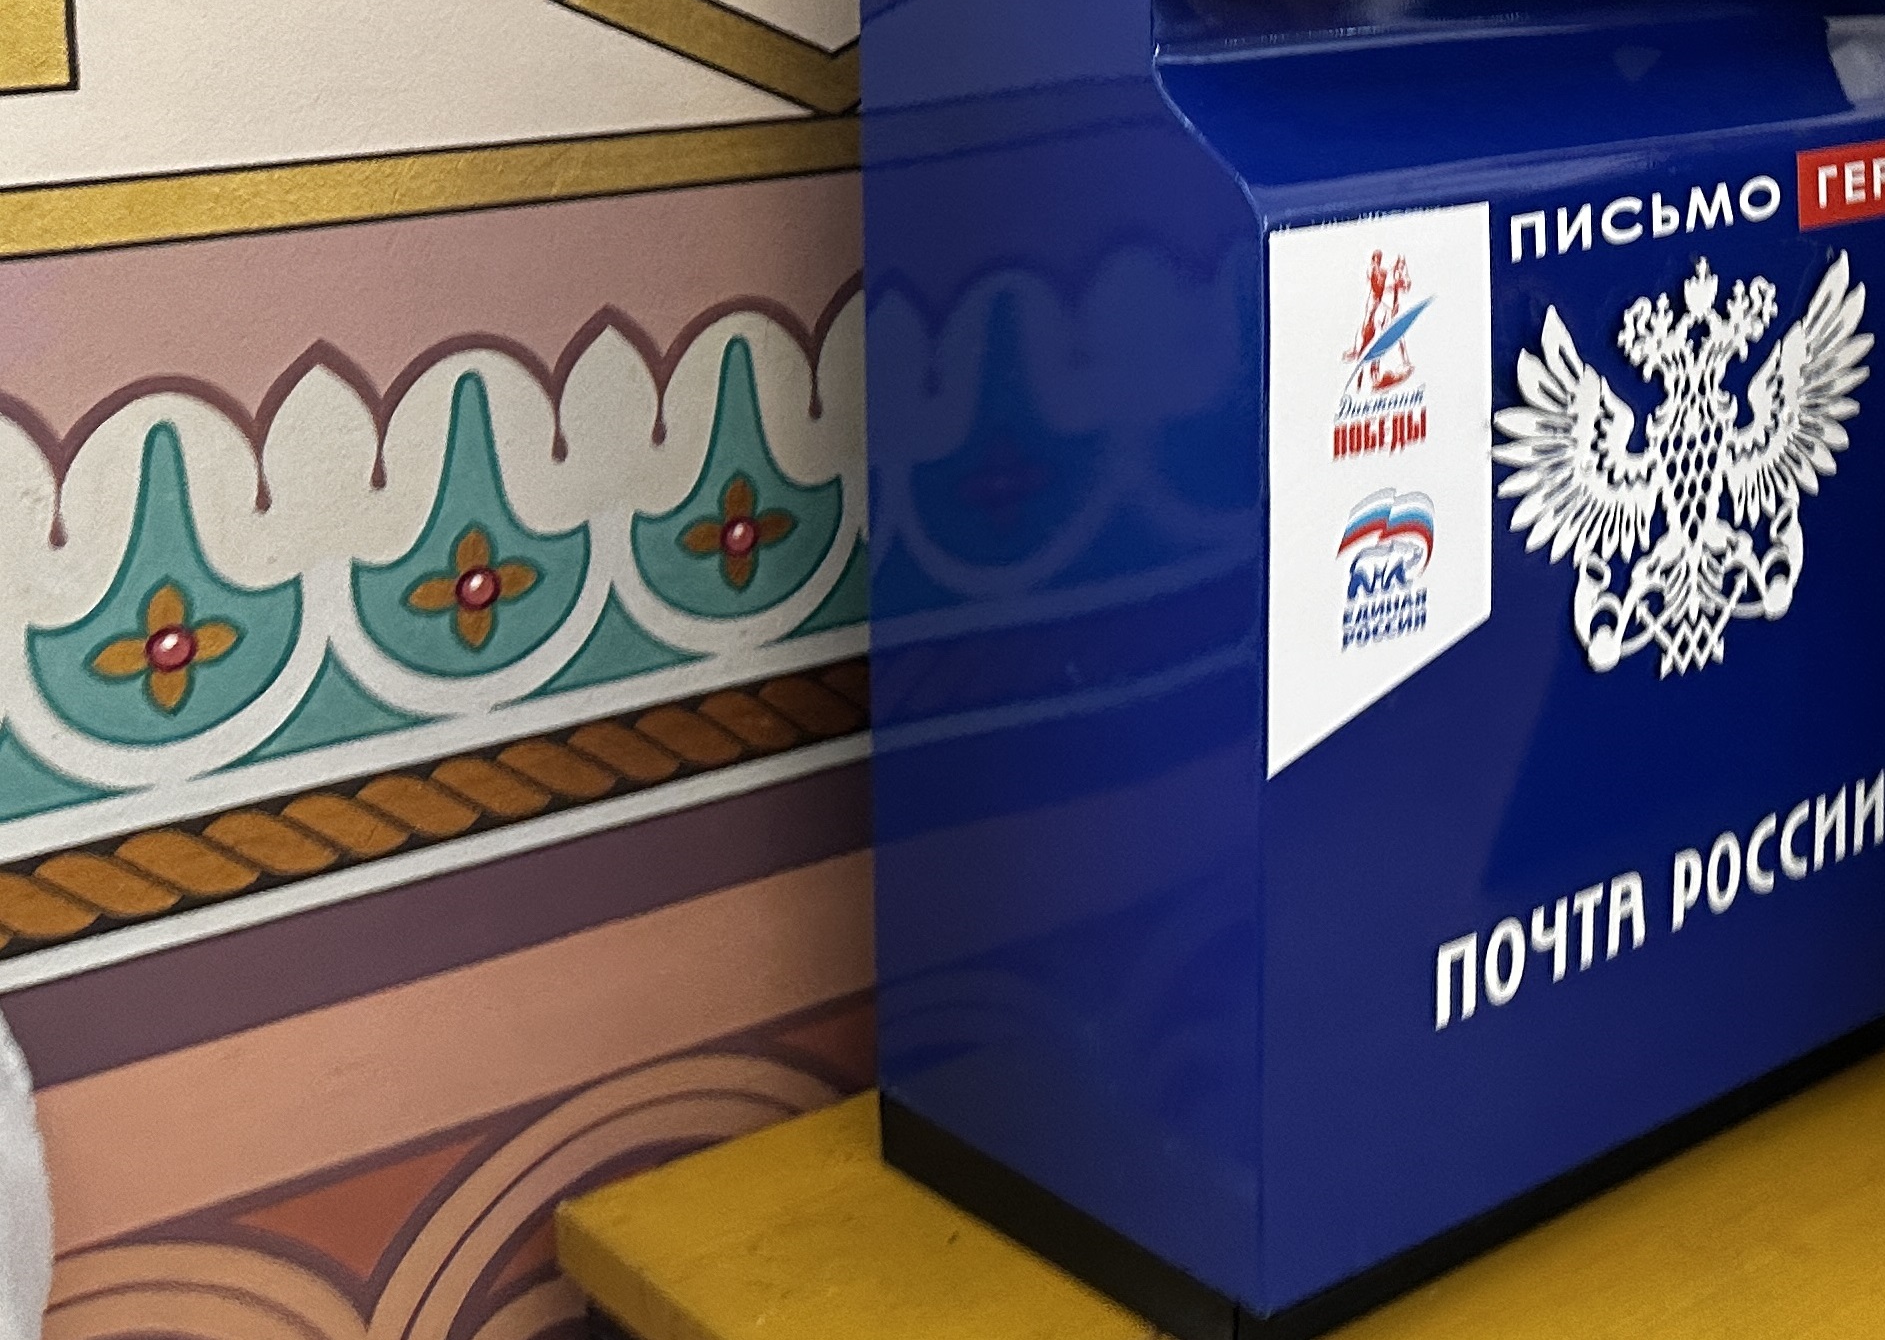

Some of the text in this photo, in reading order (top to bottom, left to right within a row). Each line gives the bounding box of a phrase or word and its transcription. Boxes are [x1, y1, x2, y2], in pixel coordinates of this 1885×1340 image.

[1510, 174, 1782, 264] ПИСЬМО
[1332, 406, 1427, 462] ПОБЕДЫ
[1341, 608, 1427, 652] РОССИЯ
[1342, 588, 1428, 627] ЕДИНАЯ
[1434, 767, 1885, 1033] ПОЧТА РОССИИ
